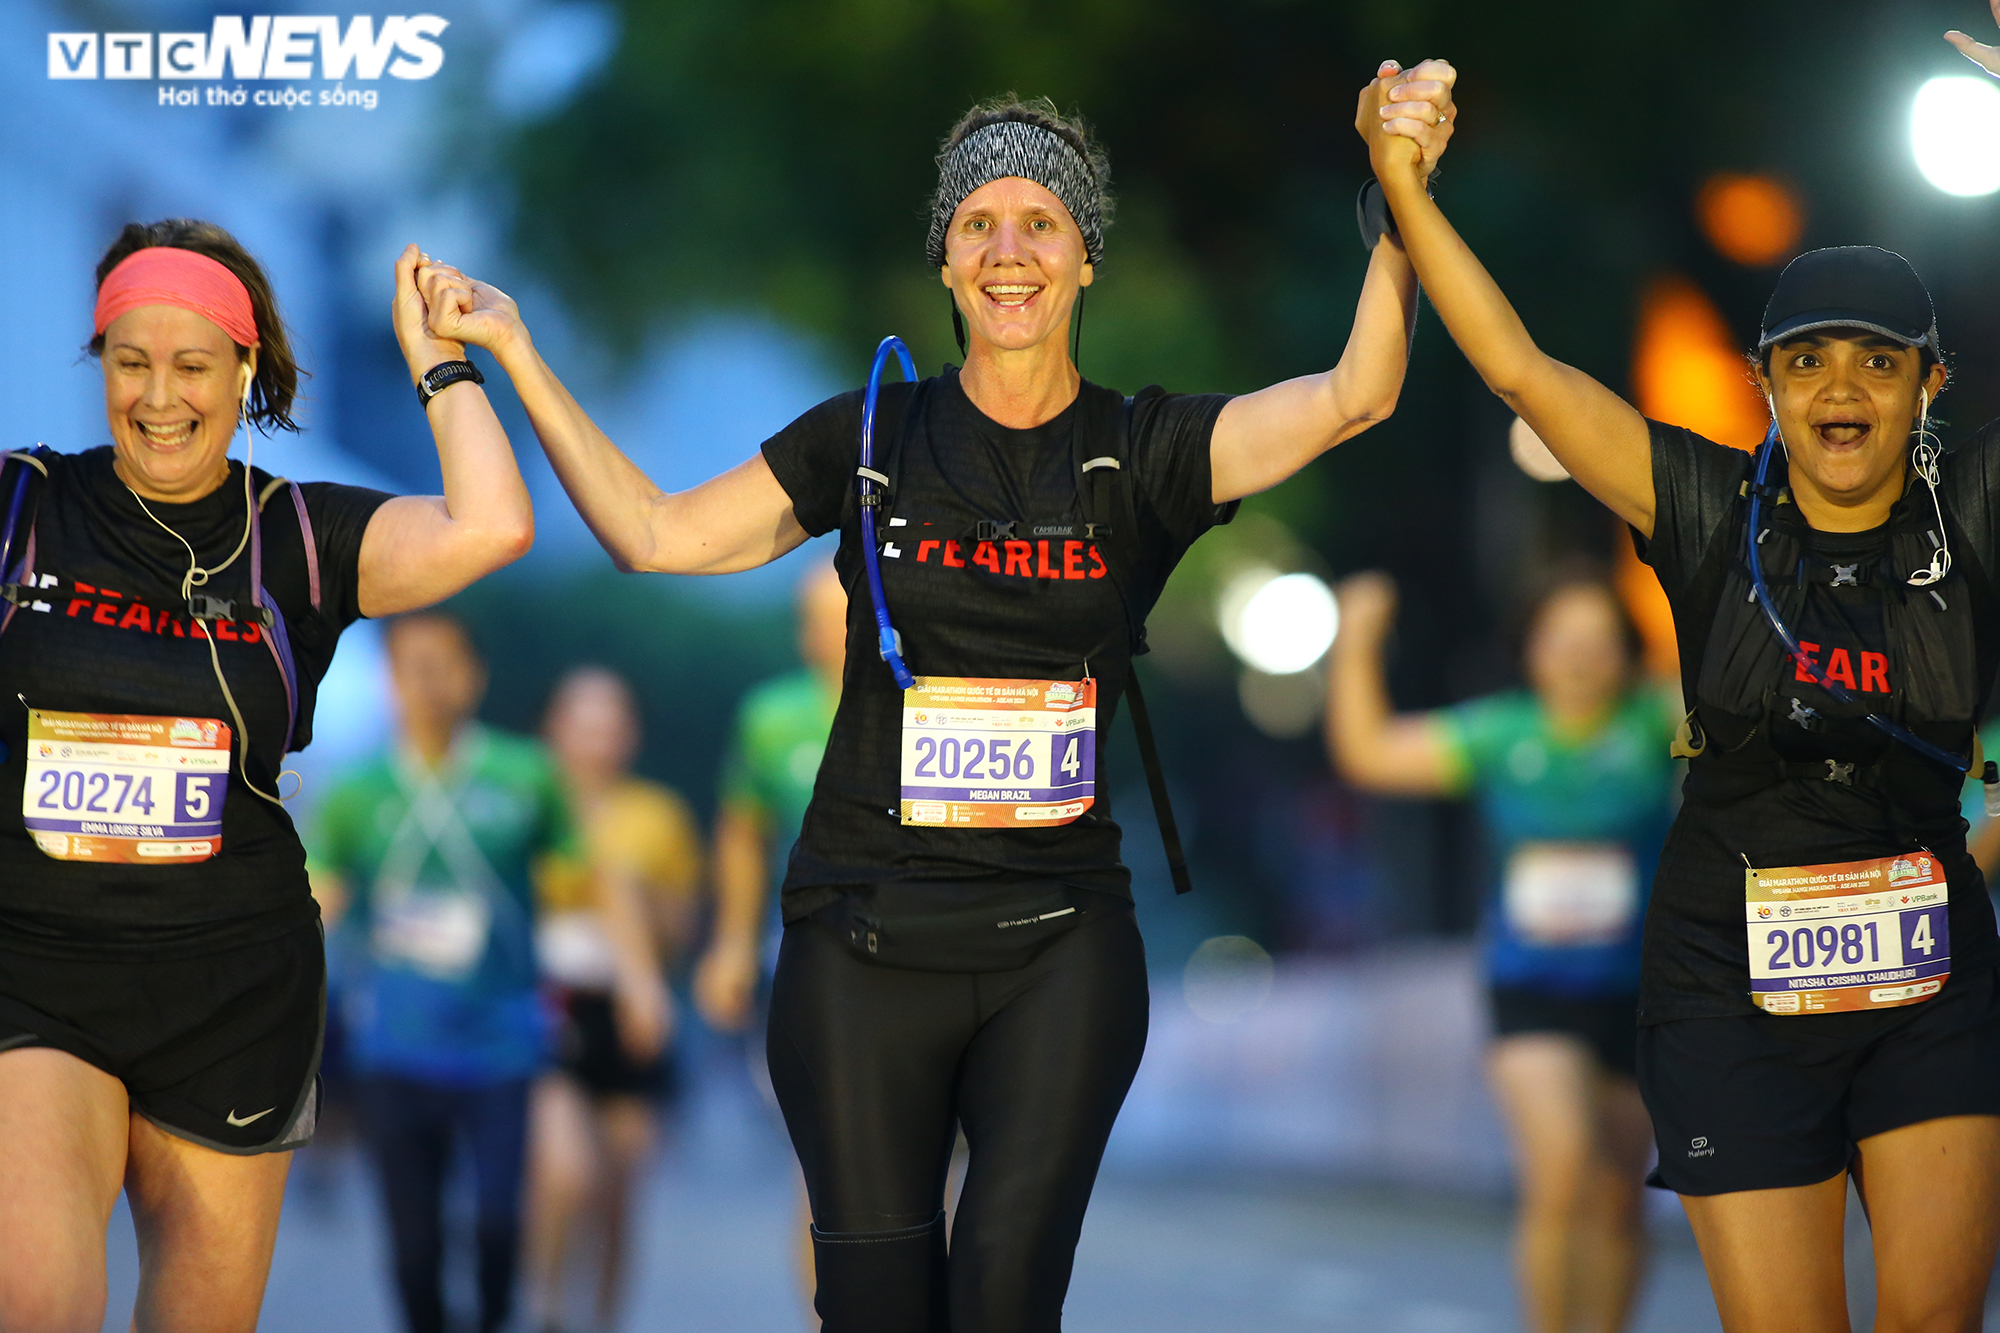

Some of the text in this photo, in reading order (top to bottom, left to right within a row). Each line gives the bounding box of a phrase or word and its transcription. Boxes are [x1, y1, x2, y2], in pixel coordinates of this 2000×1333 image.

[932, 686, 966, 695] MARATHON
[1065, 717, 1086, 727] VPBank
[915, 737, 1035, 780] 20256
[1061, 737, 1080, 778] 4
[37, 770, 155, 815] 20274
[184, 776, 211, 819] 5
[969, 790, 1031, 801] MEGAN BRAZIL
[81, 821, 165, 837] EMMA LOUISE SILVA
[1773, 877, 1809, 887] MARATHON
[1837, 874, 1844, 882] DI
[1858, 880, 1870, 888] 2020
[1911, 893, 1938, 903] VPBank
[1910, 914, 1935, 955] 4
[1767, 921, 1879, 970] 20981
[1789, 968, 1916, 988] NITASHA CRISHNA CHAUDHURI
